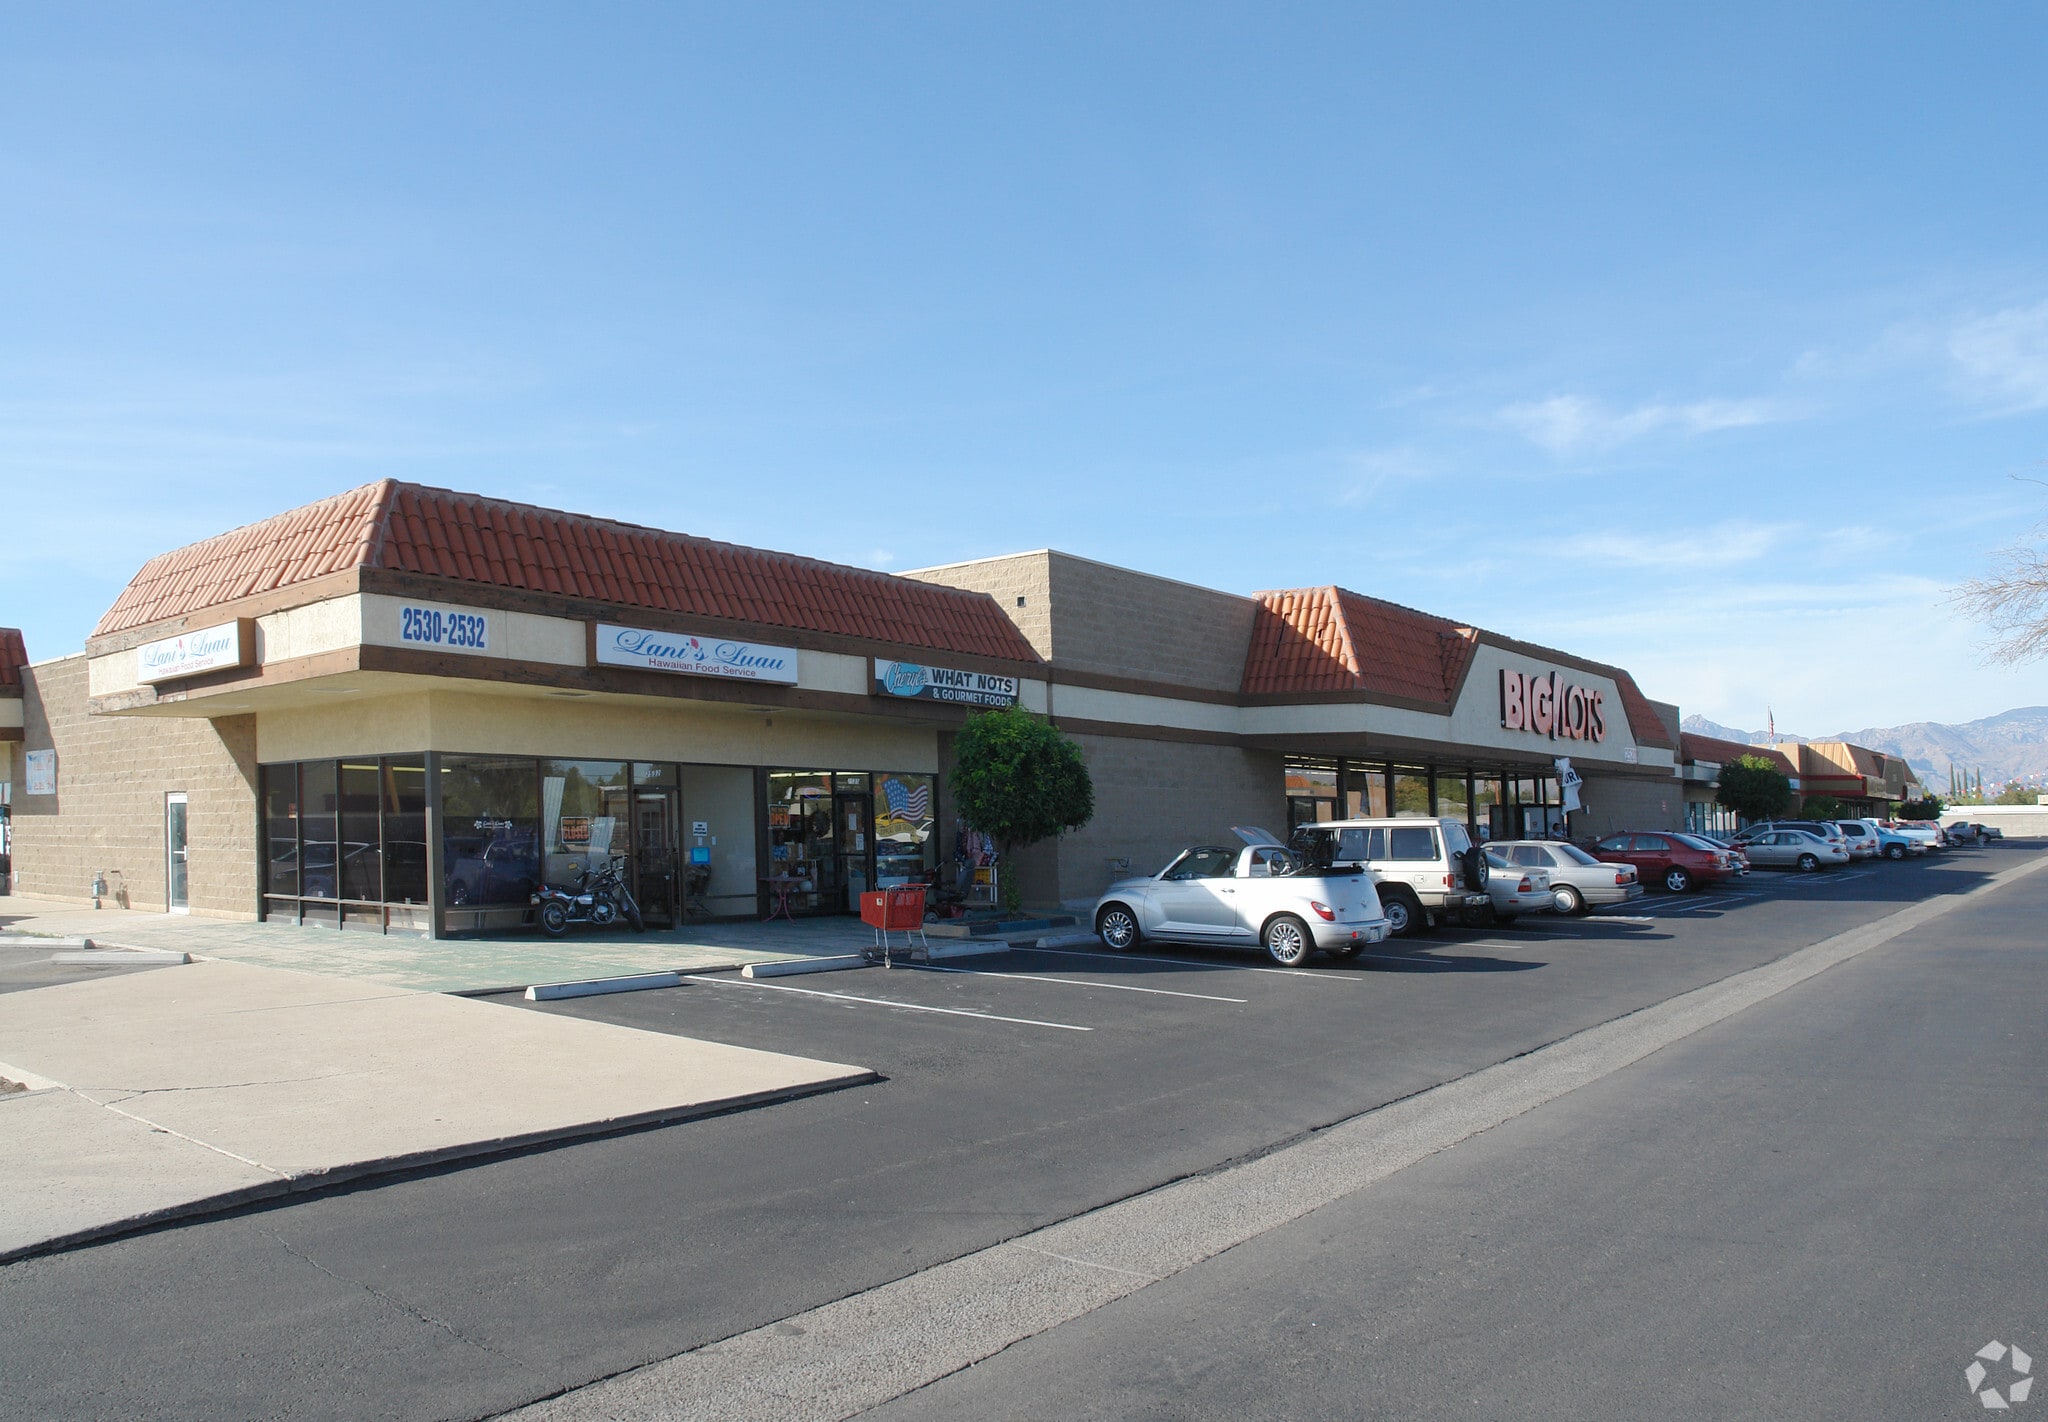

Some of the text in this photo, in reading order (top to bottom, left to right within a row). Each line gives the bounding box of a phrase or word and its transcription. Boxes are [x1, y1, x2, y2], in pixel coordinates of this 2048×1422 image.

[403, 607, 486, 648] 2530-2532
[144, 633, 230, 667] Lani's Luau
[612, 630, 786, 671] Lani's Luau
[181, 661, 195, 670] Food
[648, 657, 757, 678] Hawaiian Food Service
[886, 661, 1013, 693] Cheryl's WHAT NOTS
[932, 688, 1012, 707] & GOURMET FOODS
[770, 813, 790, 826] OPEN
[563, 825, 588, 840] CLOSED
